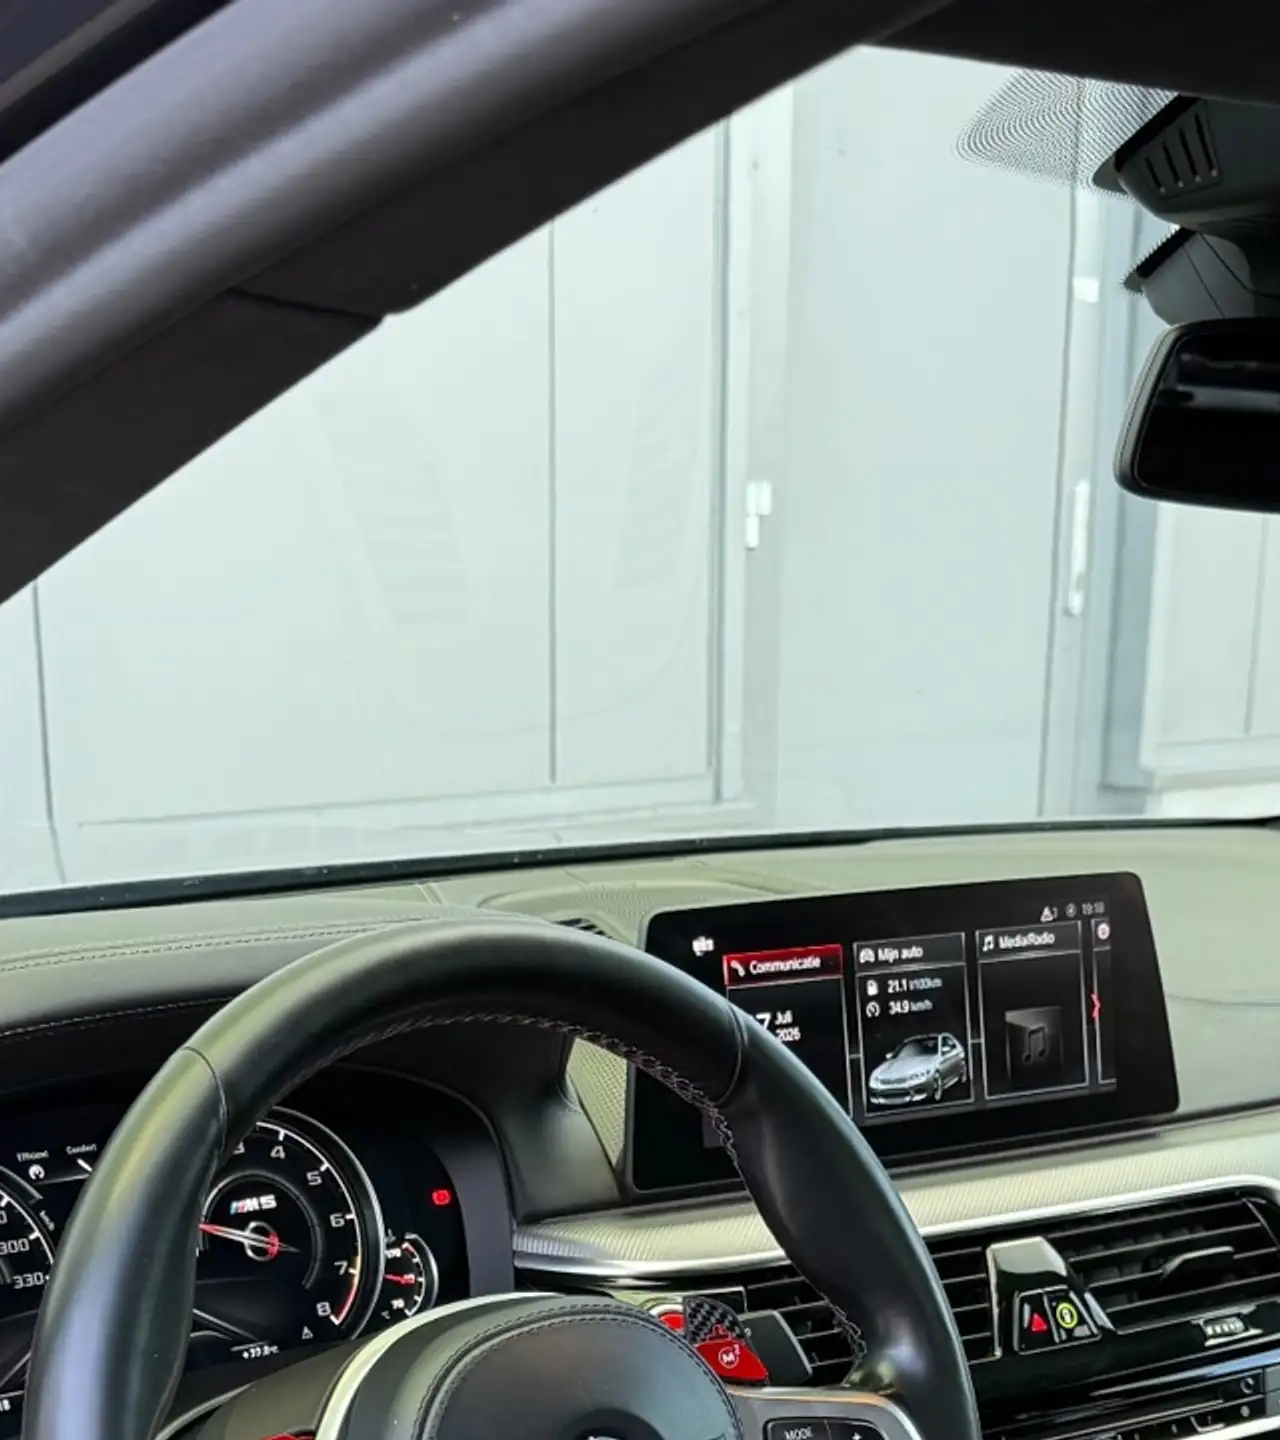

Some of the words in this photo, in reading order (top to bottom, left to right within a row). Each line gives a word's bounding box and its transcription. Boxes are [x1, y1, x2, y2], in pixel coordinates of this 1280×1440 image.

[877, 948, 899, 963] Mijn
[900, 946, 924, 960] auto
[749, 956, 822, 975] Communicatie
[888, 978, 907, 993] 21.1
[270, 1145, 287, 1159] 4
[306, 1170, 322, 1186] 5
[329, 1213, 345, 1228] 6
[334, 1261, 349, 1275] 7
[12, 1272, 44, 1289] 330
[317, 1301, 332, 1316] 8
